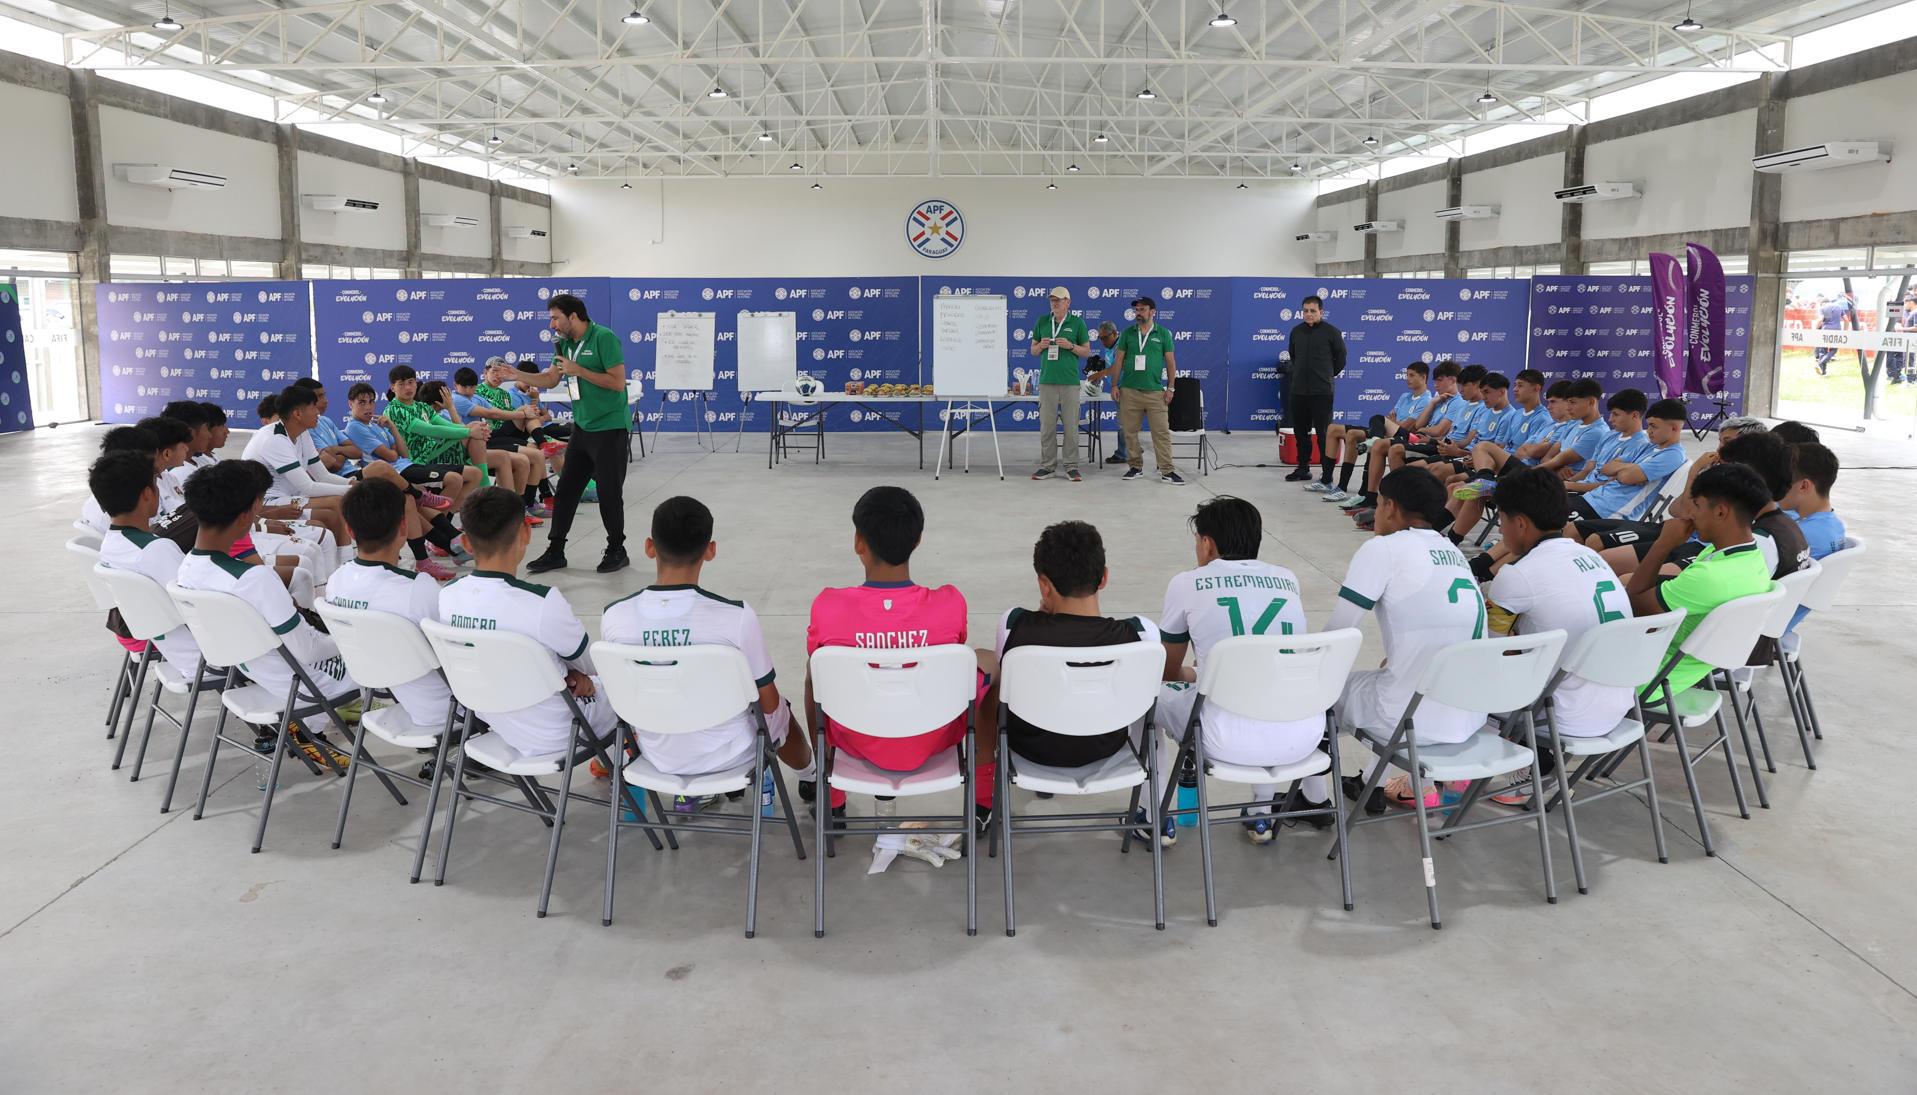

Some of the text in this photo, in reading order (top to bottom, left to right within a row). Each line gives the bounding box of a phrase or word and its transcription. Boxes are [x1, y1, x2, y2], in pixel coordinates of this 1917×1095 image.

[926, 205, 944, 214] APF
[410, 291, 426, 300] APF
[644, 290, 660, 299] APF
[716, 290, 733, 298] APF
[790, 290, 807, 298] APF
[864, 289, 881, 297] APF
[1028, 288, 1046, 296] APF
[1102, 289, 1119, 297] APF
[1176, 290, 1193, 298] APF
[1331, 290, 1348, 298] APF
[1473, 291, 1490, 299] APF
[217, 293, 229, 301] APF
[269, 293, 281, 301] APF
[244, 314, 256, 322] APF
[376, 313, 392, 321] APF
[517, 311, 534, 320] APF
[827, 311, 844, 319] APF
[1437, 312, 1454, 320] APF
[1690, 305, 1699, 344] CONMEBO
[1698, 288, 1711, 362] EVOLUCIÓN
[412, 333, 428, 341] APF
[717, 332, 734, 340] APF
[864, 332, 881, 340] APF
[1175, 332, 1192, 340] APF
[1472, 332, 1488, 340] APF
[828, 350, 844, 358] APF
[379, 354, 394, 363] APF
[272, 371, 284, 379] APF
[718, 371, 735, 379] APF
[864, 370, 881, 378] APF
[247, 391, 259, 399] APF
[719, 413, 736, 421] APF
[1100, 411, 1117, 419] APF
[1216, 597, 1292, 636] 14
[451, 614, 496, 630] ROMERO
[642, 628, 692, 646] PEREZ
[856, 630, 928, 648] SANCHEZ
